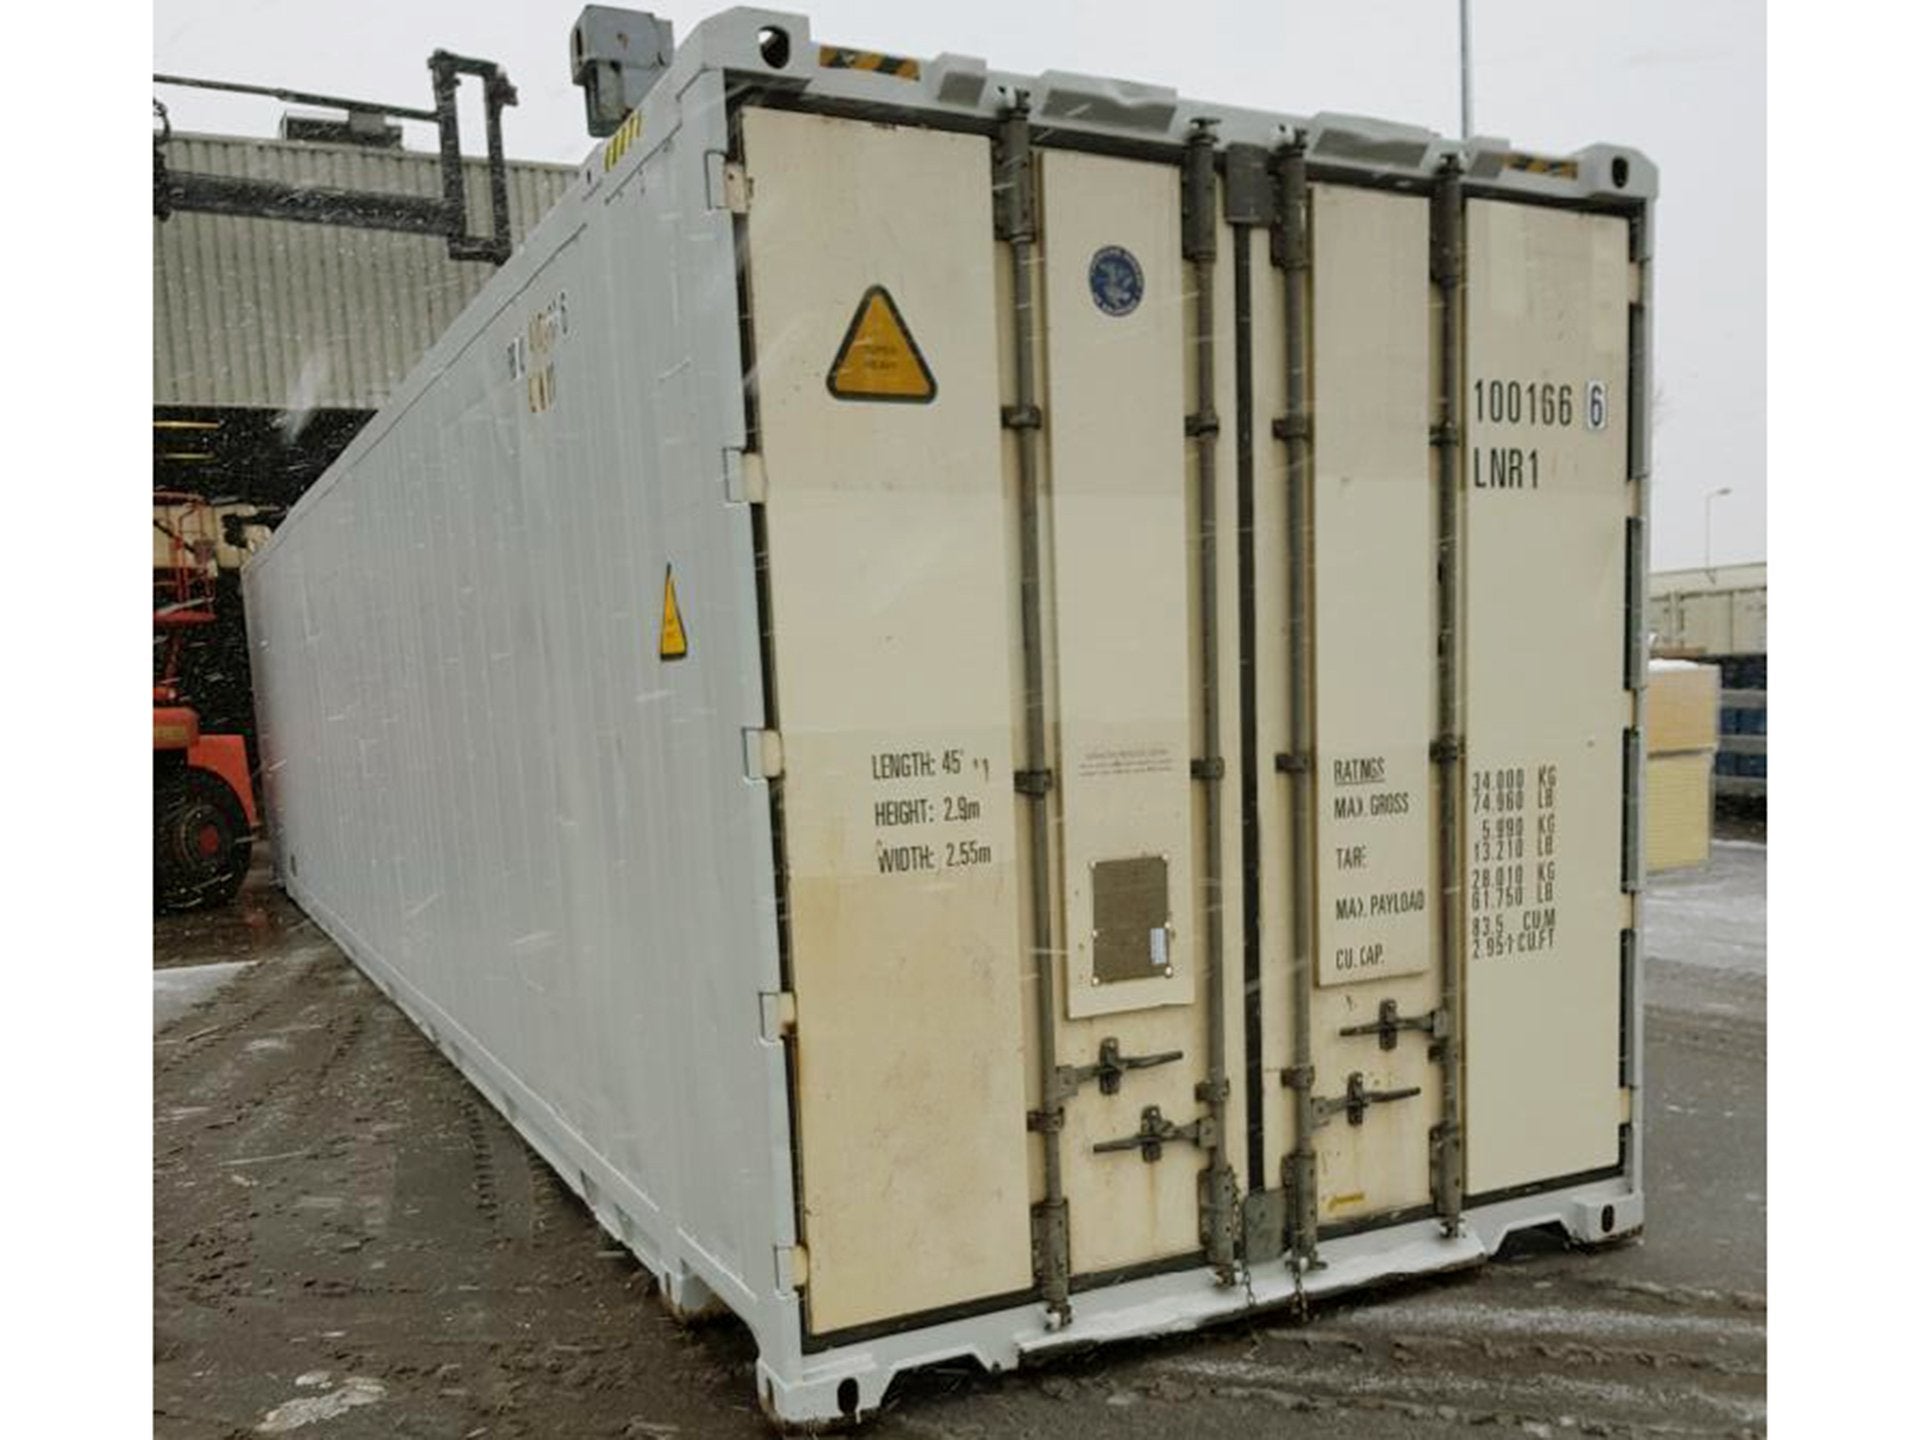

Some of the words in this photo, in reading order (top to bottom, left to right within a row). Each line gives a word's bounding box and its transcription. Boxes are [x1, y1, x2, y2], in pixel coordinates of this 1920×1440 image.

[1474, 379, 1572, 426] 100166
[1590, 384, 1603, 426] 6
[1474, 447, 1538, 489] LNR1
[871, 752, 936, 780] LENGTH:
[1538, 765, 1557, 788] KG
[1370, 792, 1409, 816] GROSS
[1538, 787, 1553, 809] LB
[874, 799, 935, 826] HEIGHT:
[943, 796, 980, 822] 2.9m
[1538, 813, 1556, 835] KG
[878, 845, 935, 873] WIDTH:
[946, 840, 991, 867] 2.55m
[1538, 834, 1553, 857] LB
[1538, 861, 1556, 883] KG
[1370, 889, 1425, 916] PAYLOAD
[1538, 881, 1554, 904] LB
[1360, 943, 1385, 967] CAP.
